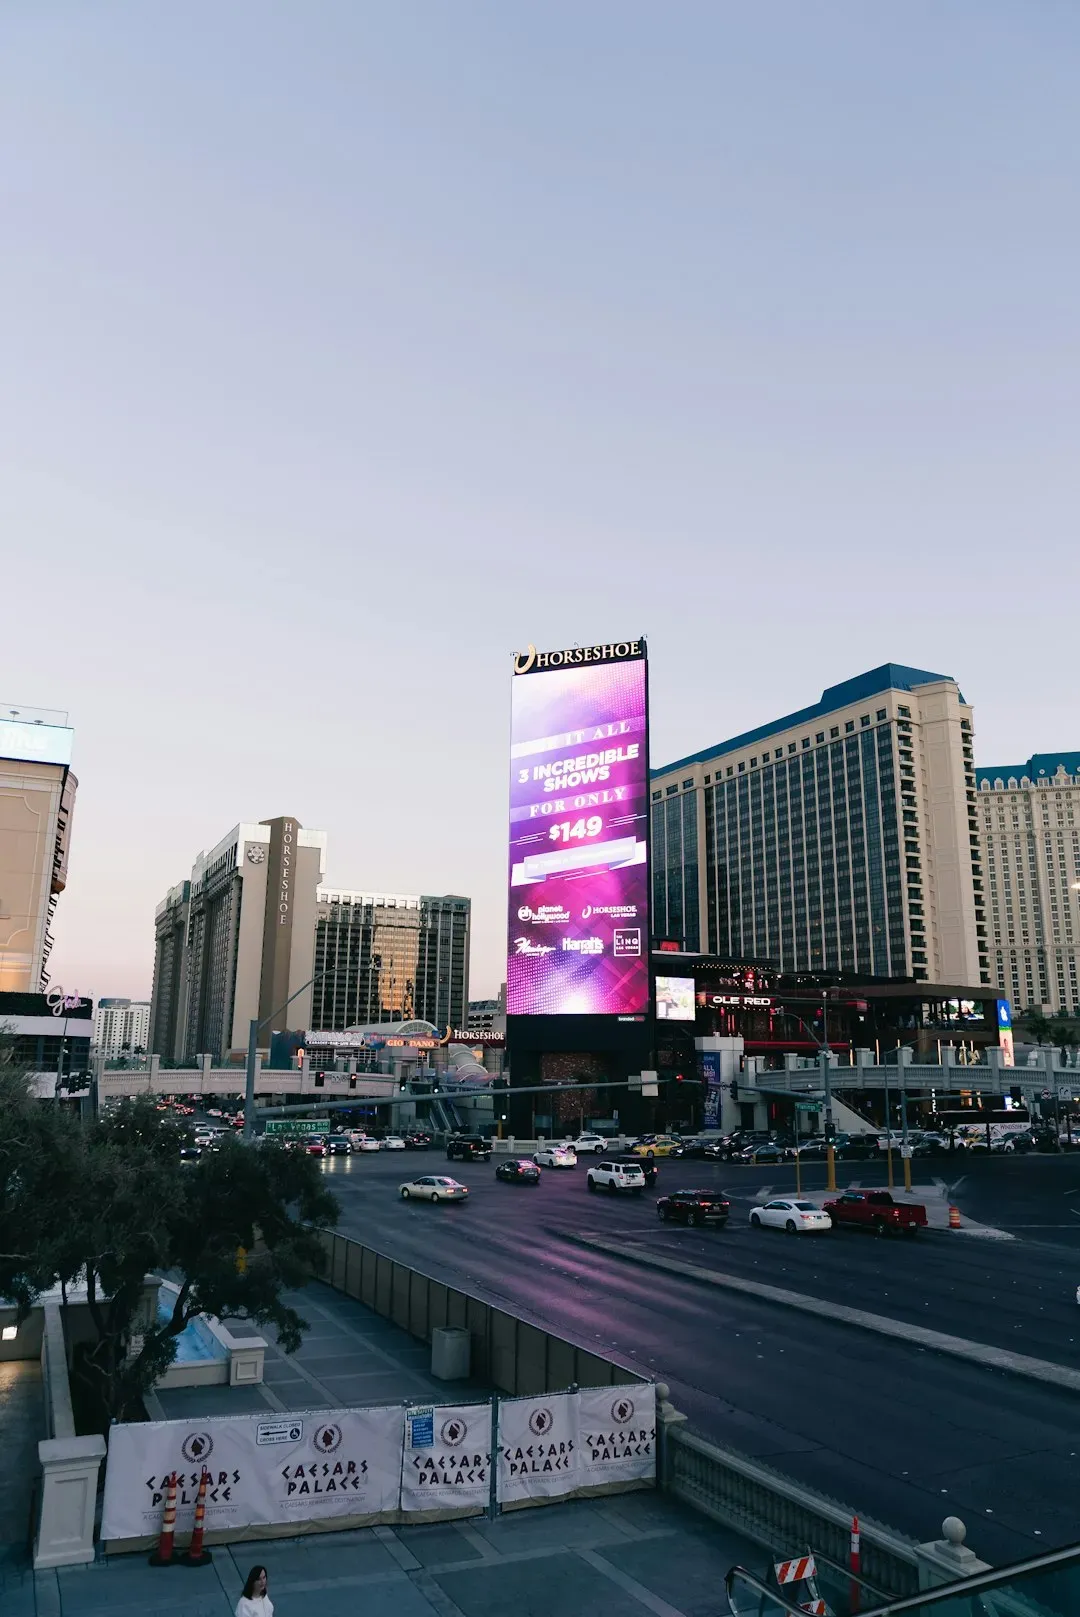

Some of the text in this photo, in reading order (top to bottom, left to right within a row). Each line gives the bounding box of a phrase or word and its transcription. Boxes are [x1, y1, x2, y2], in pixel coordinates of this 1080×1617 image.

[565, 721, 631, 745] IT ALL
[518, 768, 530, 784] 3
[533, 743, 640, 780] INCREDIBLE
[543, 765, 611, 793] SHOWS
[529, 787, 627, 818] FOR ONLY
[548, 815, 603, 842] $149
[279, 822, 292, 925] HORSESHOE
[532, 911, 570, 922] hollywood
[537, 905, 564, 915] planet
[615, 938, 639, 946] LINQ
[712, 995, 771, 1006] OLE RED
[453, 1030, 505, 1041] HORSESHOE
[290, 1123, 316, 1132] Vegas
[585, 1428, 657, 1447] CAESARS
[412, 1453, 491, 1469] CAESARS
[503, 1440, 574, 1461] CAESARS
[591, 1443, 651, 1461] PALACE
[281, 1459, 369, 1480] CAESARS
[510, 1455, 569, 1476] PALACE
[287, 1475, 360, 1496] PALACE
[419, 1469, 486, 1485] PALACE
[151, 1486, 232, 1507] PLCE
